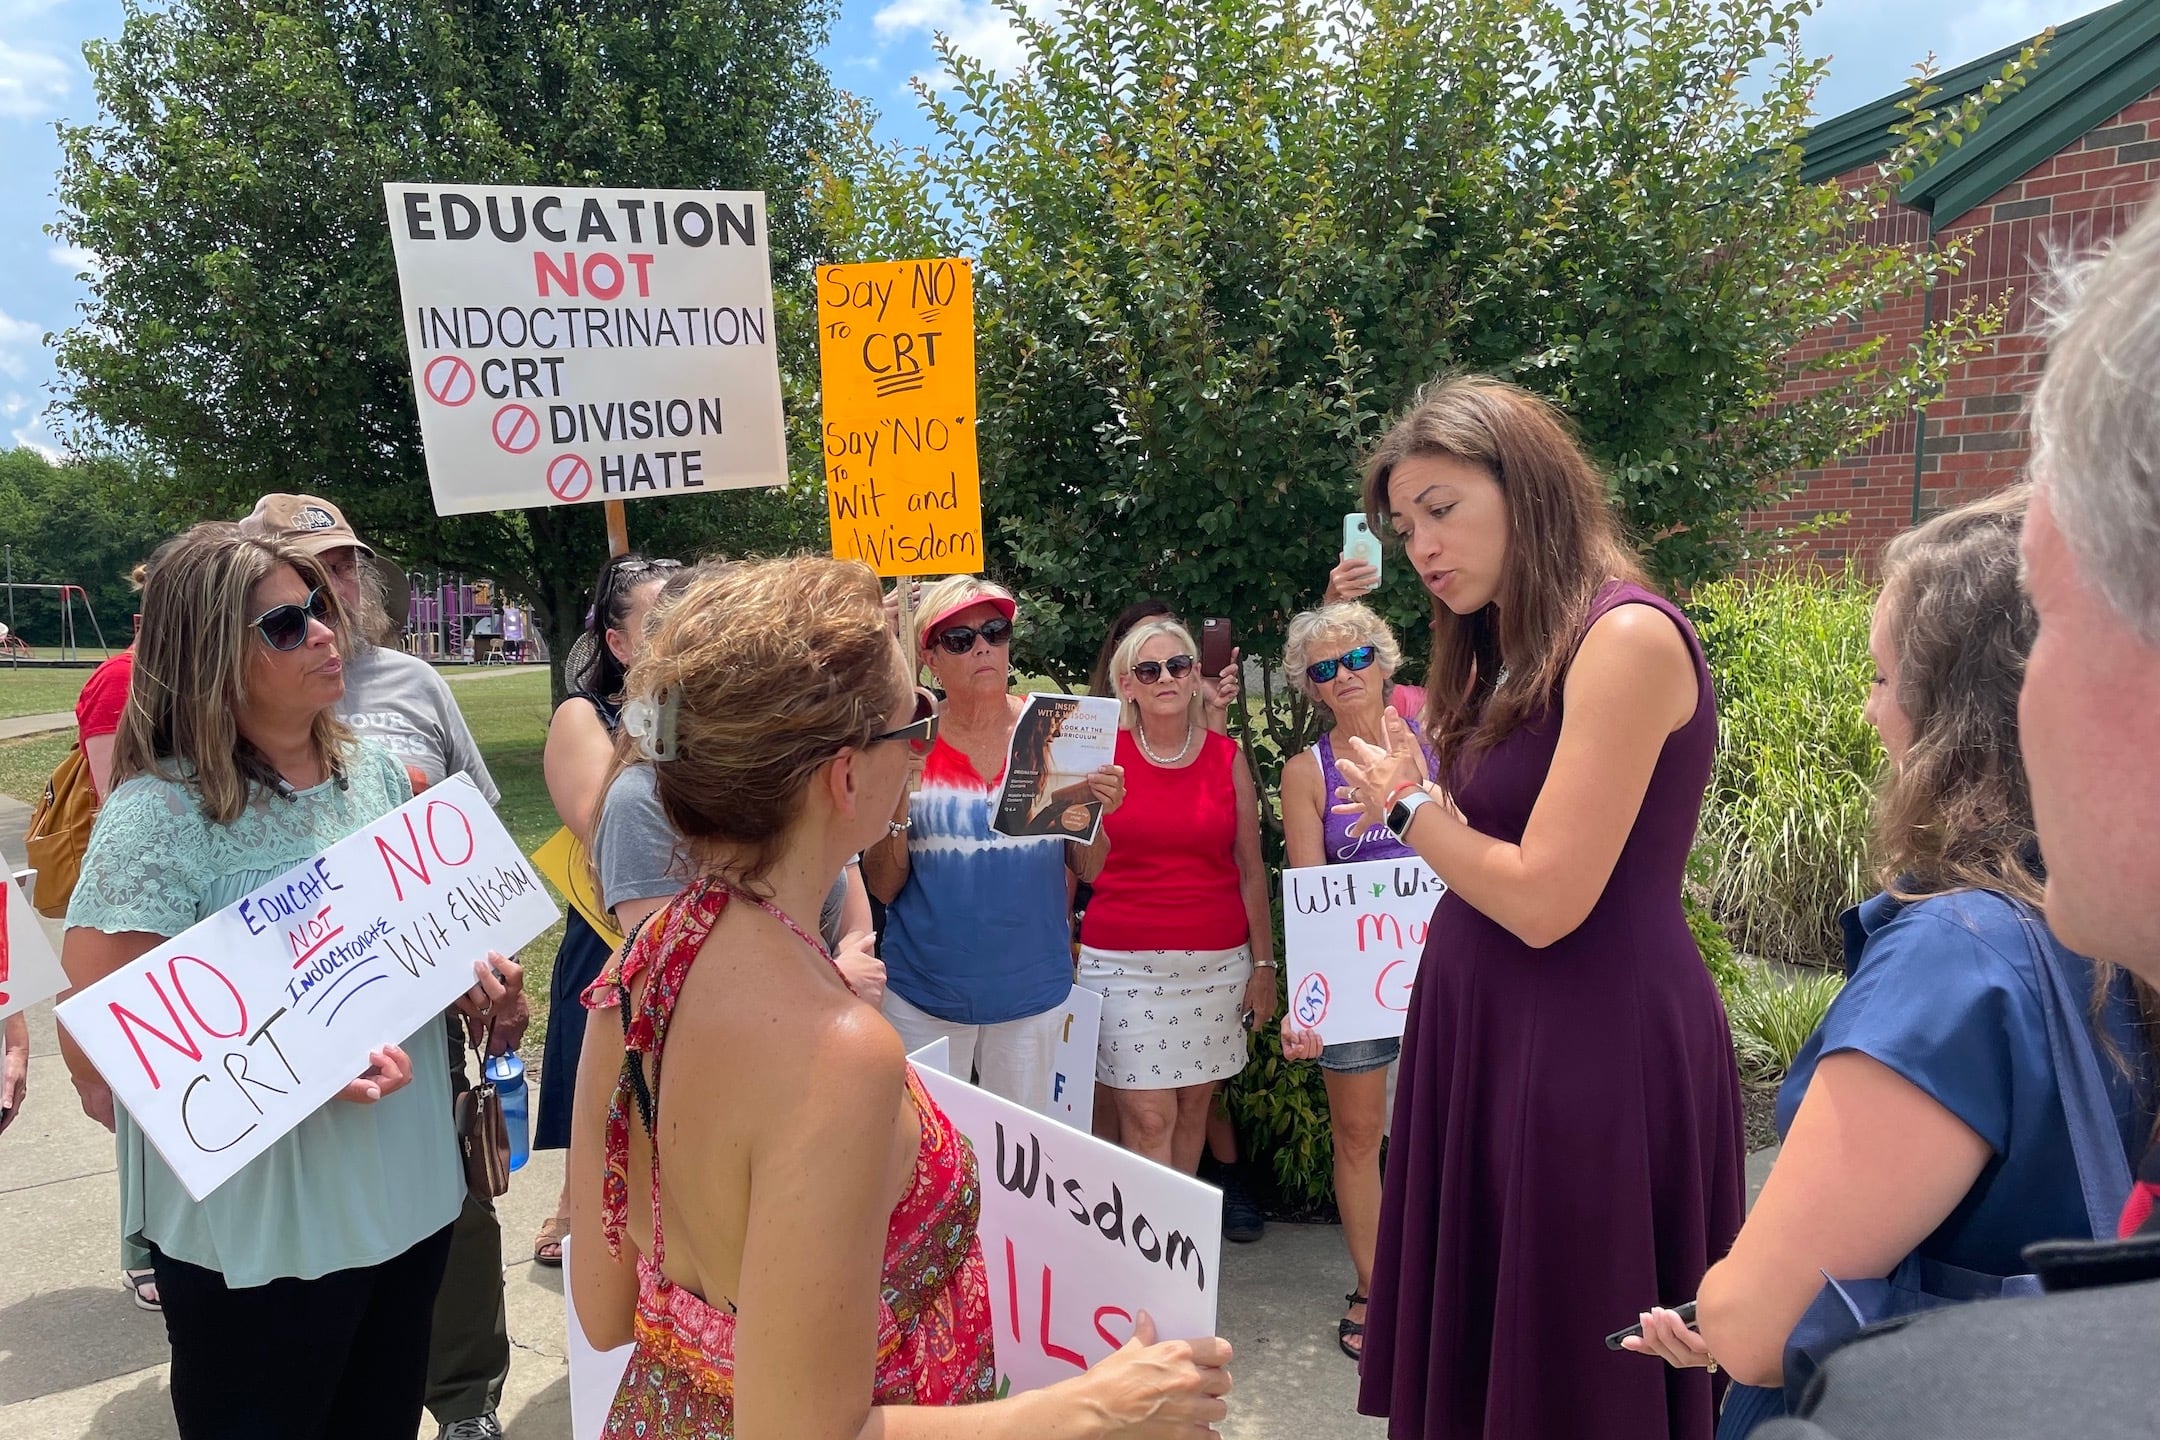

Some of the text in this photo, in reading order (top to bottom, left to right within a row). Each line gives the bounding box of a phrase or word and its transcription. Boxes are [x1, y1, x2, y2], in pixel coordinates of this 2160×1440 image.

[403, 193, 755, 247] EDUCATION
[534, 252, 654, 300] NOT
[826, 268, 893, 322] Say
[418, 307, 765, 349] INDOCTRINATION
[863, 332, 942, 374] CRT
[481, 357, 564, 398] CRT
[550, 398, 722, 444] DIVISION
[827, 422, 879, 467] Say
[601, 450, 703, 493] HATE
[908, 471, 957, 512] and
[291, 511, 332, 527] NRA
[336, 713, 406, 730] OUR
[1037, 708, 1097, 721] WIT & WISDOM
[1059, 732, 1097, 741] URRICULUM
[1061, 724, 1079, 732] LOOK
[374, 800, 474, 902] NO
[1294, 874, 1357, 915] Wit
[1394, 867, 1446, 898] Wis
[288, 905, 333, 958] NOT
[383, 911, 451, 978] Wit
[1356, 912, 1429, 952] Mu
[1299, 980, 1325, 1023] CRT
[1374, 960, 1413, 1011] G
[108, 955, 248, 1090] NO
[182, 1007, 300, 1153] CRT
[995, 1121, 1205, 1292] Wisdom
